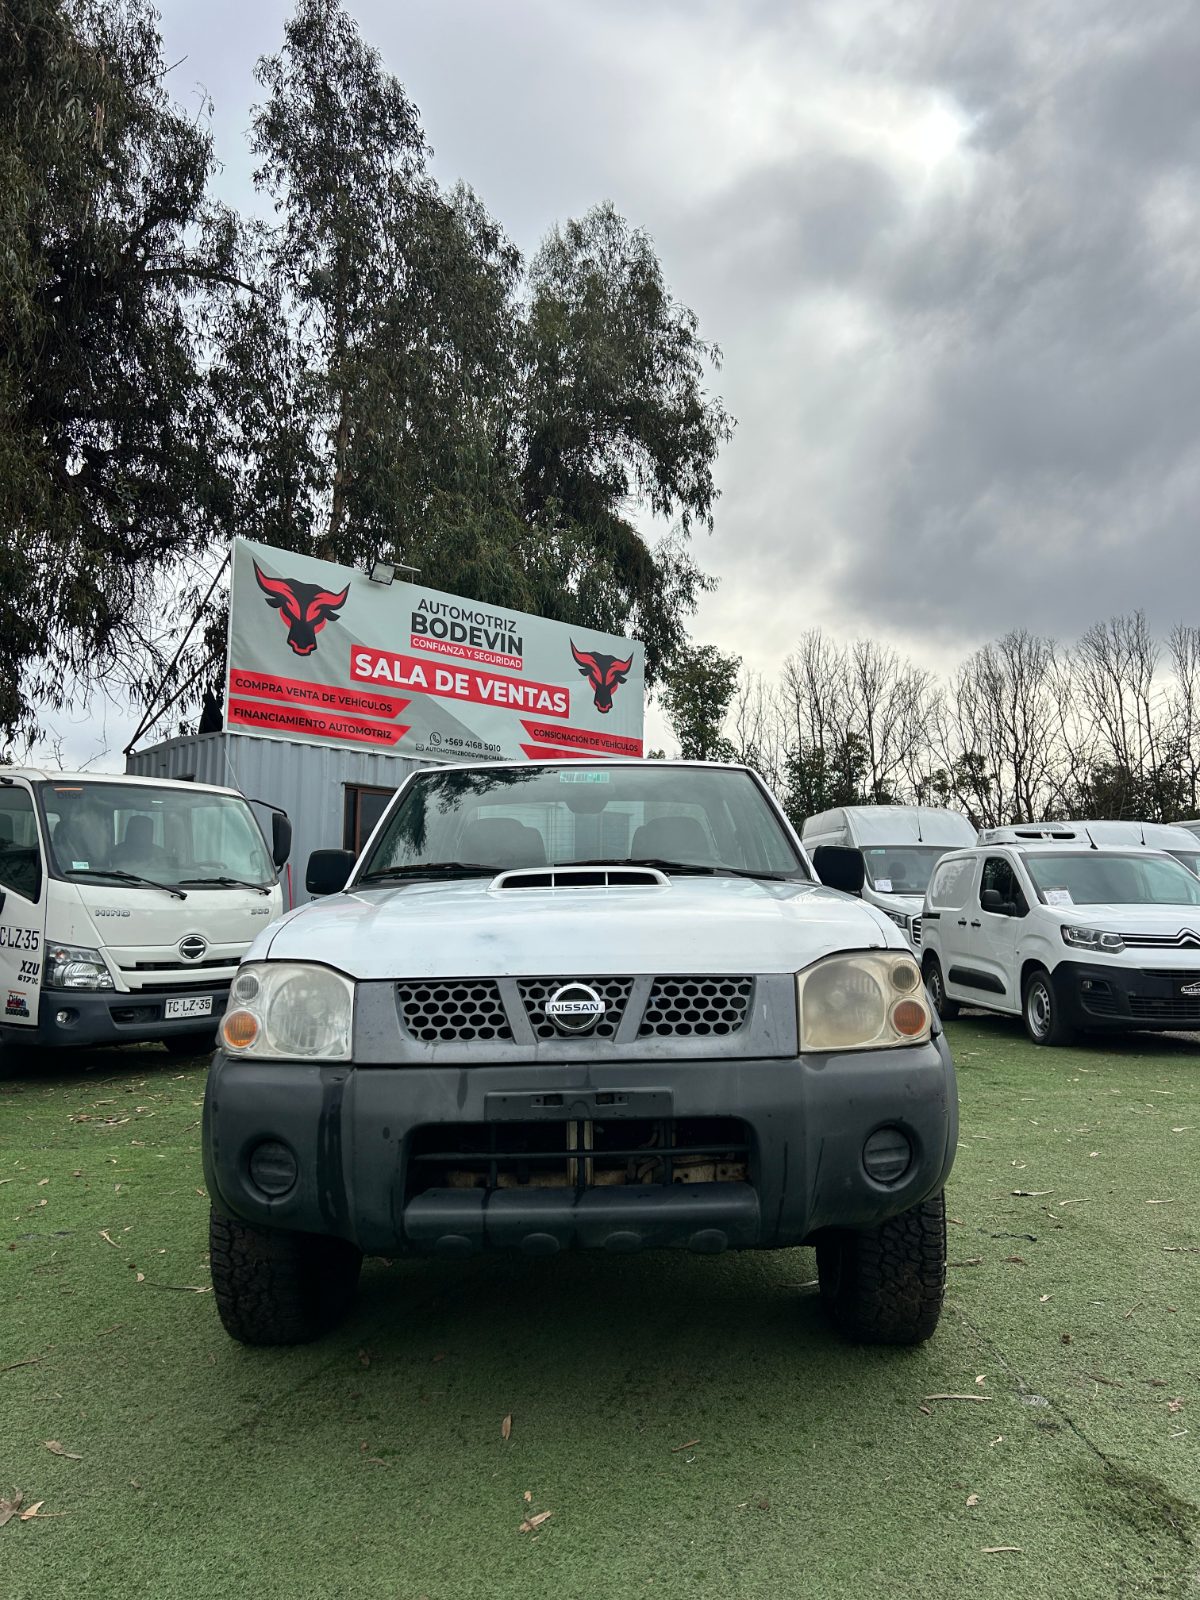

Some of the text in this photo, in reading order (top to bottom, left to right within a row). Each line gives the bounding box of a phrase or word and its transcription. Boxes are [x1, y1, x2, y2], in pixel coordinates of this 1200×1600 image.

[417, 598, 517, 633] AUTOMOTRIZ
[411, 612, 522, 656] BODEVIN
[412, 638, 522, 668] CONFIANZA Y SEGURIDAD
[235, 678, 393, 712] COMPRA VENTA DE VEHÍCULOS
[355, 653, 567, 713] SALA DE VENTAS
[233, 707, 392, 739] FINANCIAMIENTO AUTOMOTRIZ
[444, 737, 501, 752] +569 4168 5010
[533, 728, 589, 744] CONSIGNACIÓN
[601, 740, 638, 752] VEHÍCULOS
[95, 909, 131, 917] HINO
[18, 974, 31, 984] 617
[20, 960, 40, 976] XZU
[551, 1003, 599, 1012] NISSAN
